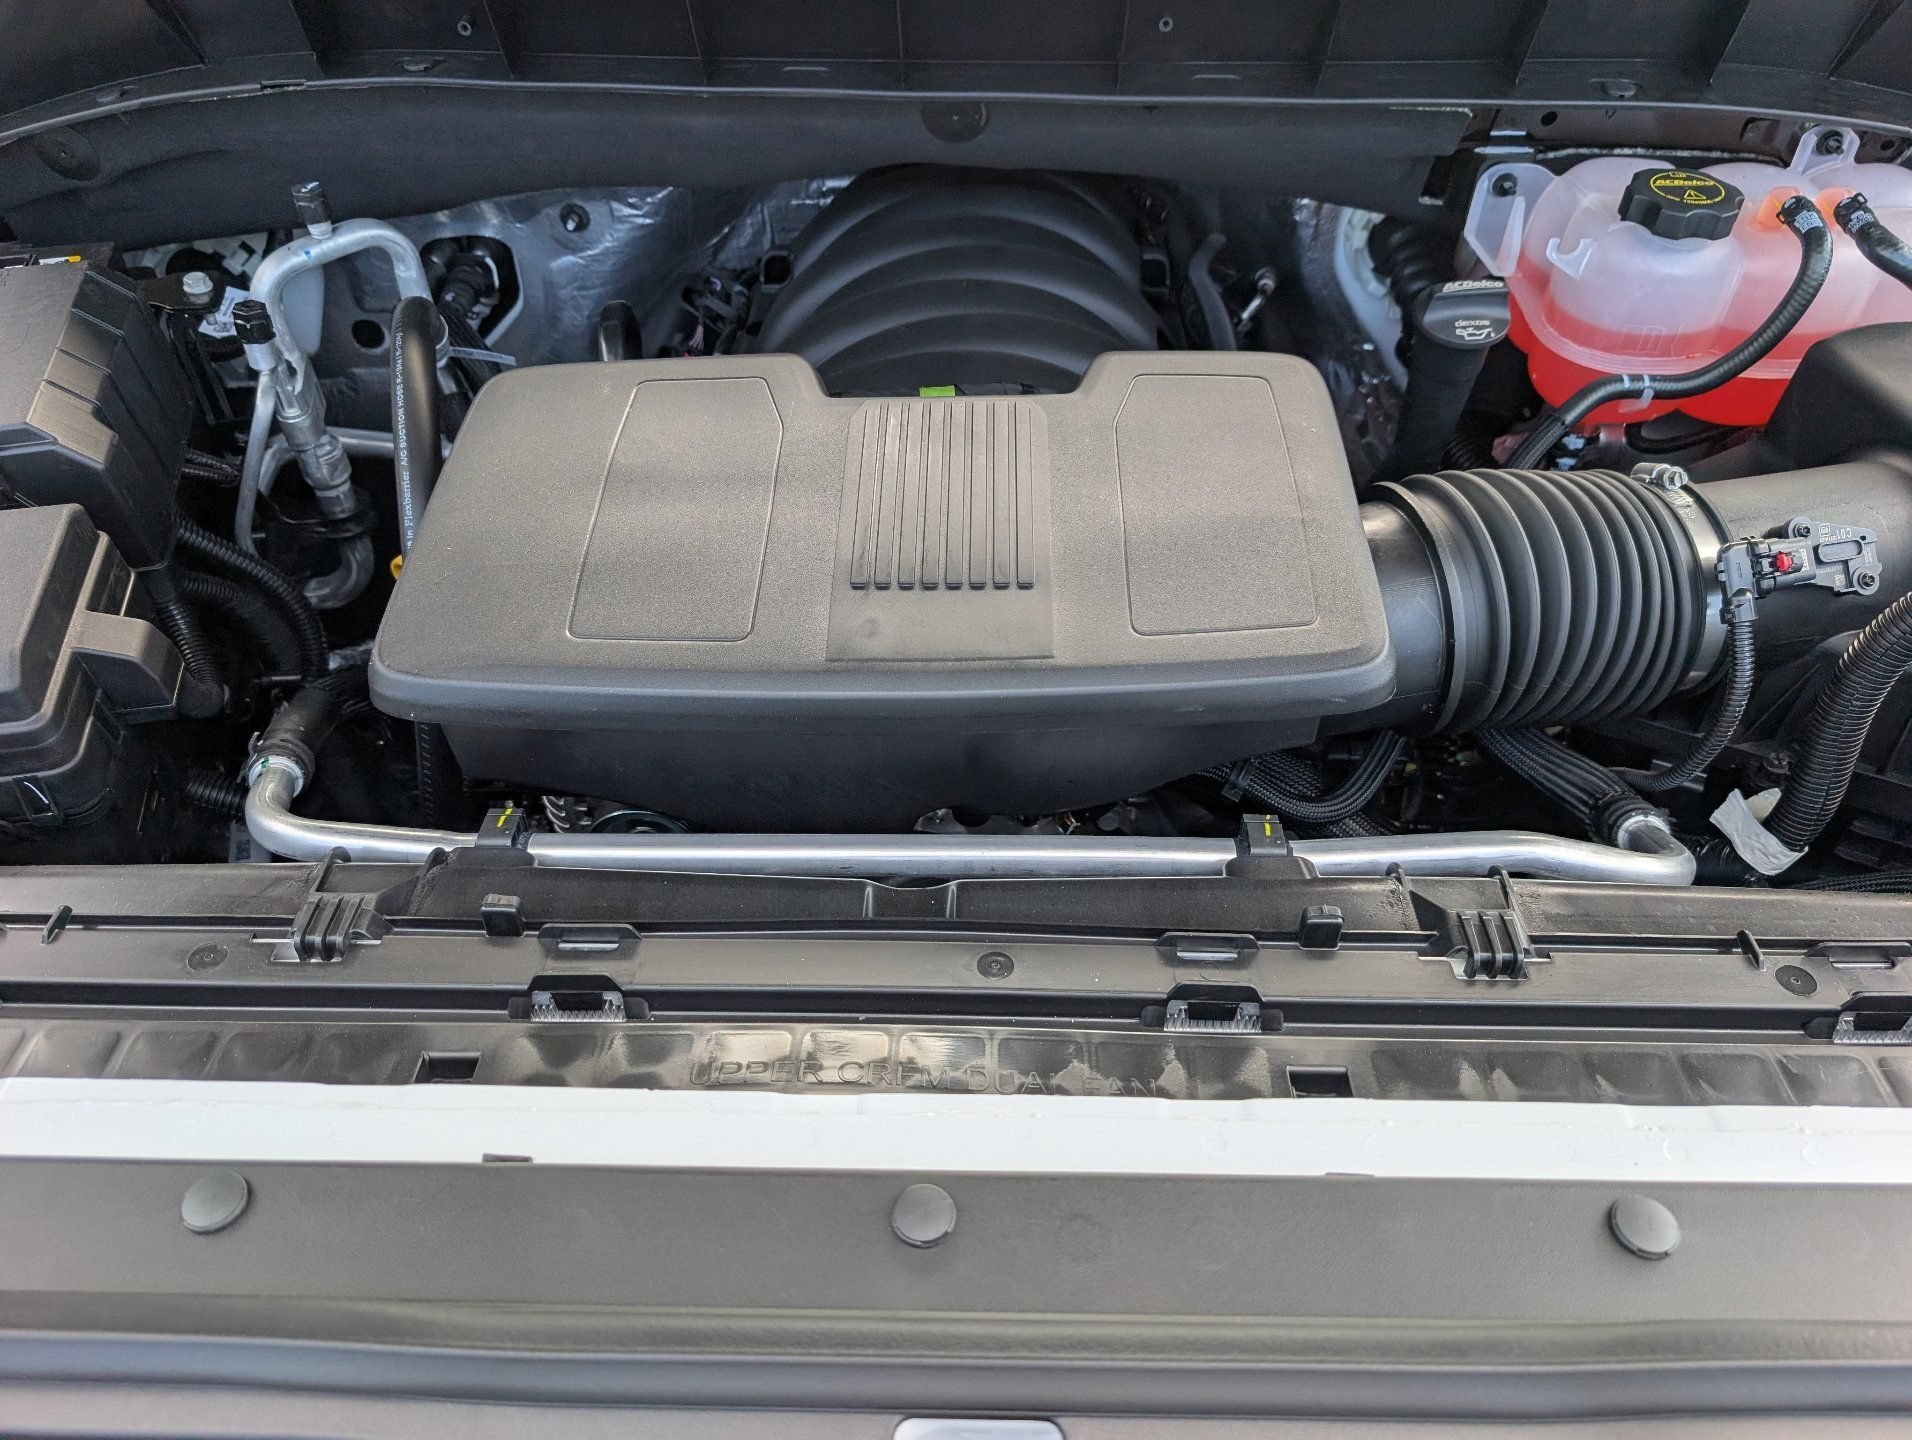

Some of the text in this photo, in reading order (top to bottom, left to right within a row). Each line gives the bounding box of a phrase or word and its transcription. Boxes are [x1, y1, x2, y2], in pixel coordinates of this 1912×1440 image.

[1653, 179, 1714, 187] ACDelco
[1443, 280, 1504, 293] ACDelco
[396, 384, 404, 407] HOSE
[690, 1060, 824, 1086] UPPER
